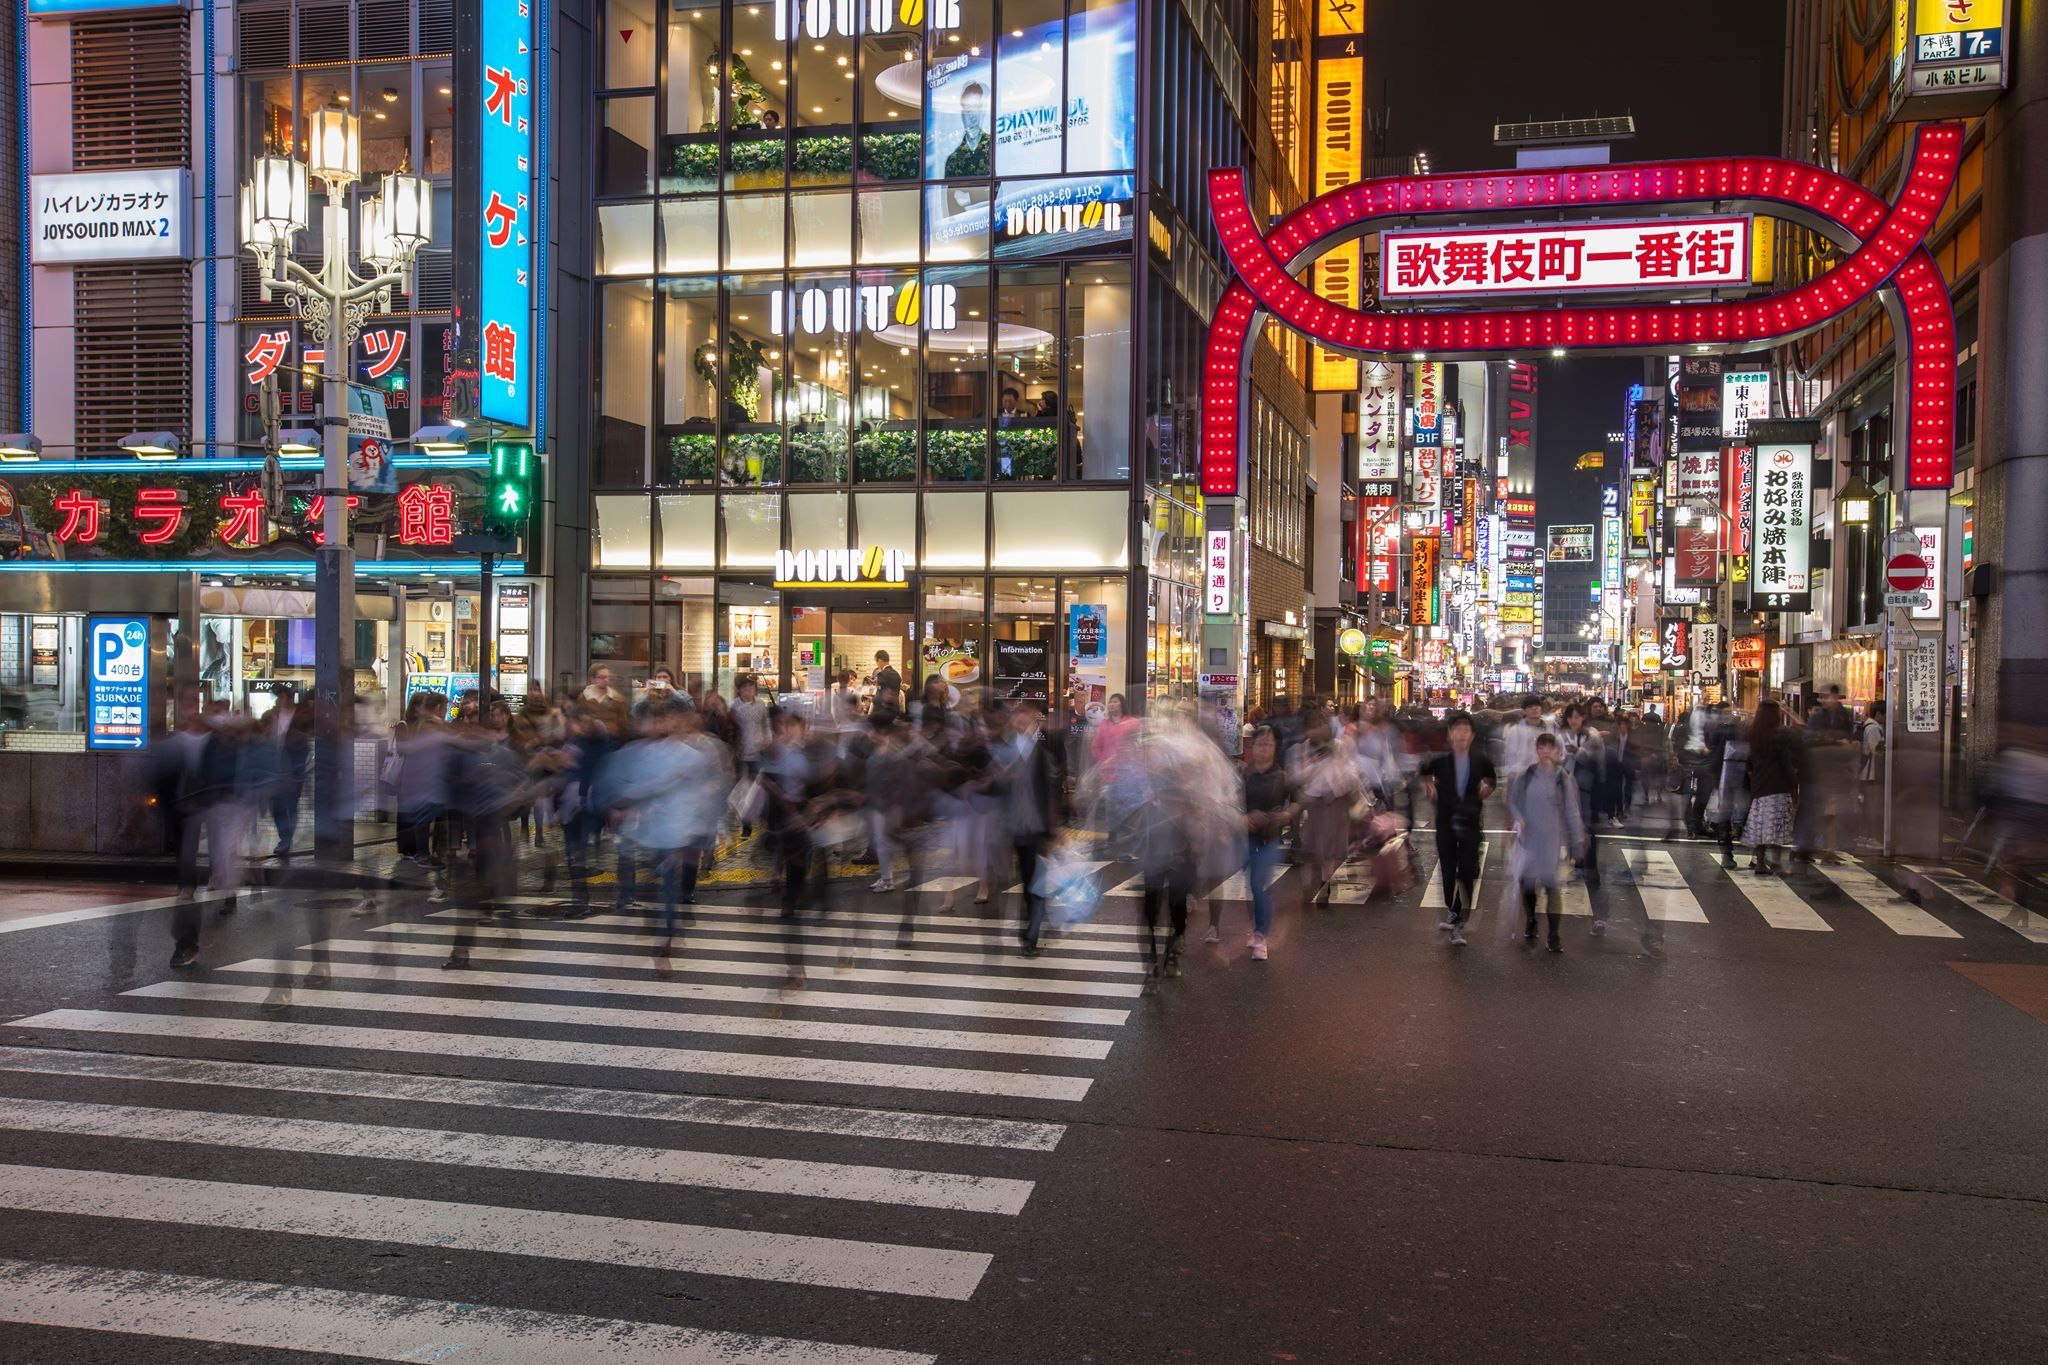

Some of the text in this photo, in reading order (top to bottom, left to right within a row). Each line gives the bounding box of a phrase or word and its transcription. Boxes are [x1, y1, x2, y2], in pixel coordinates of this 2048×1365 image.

[1345, 41, 1356, 56] 4
[1923, 32, 1992, 55] 本陣 7F
[1923, 48, 1956, 59] PART2
[1925, 67, 1987, 87] 小松ビル
[43, 191, 169, 215] ハイレゾカラオケ
[1007, 200, 1121, 237] DOUTOR
[43, 222, 119, 241] JOYSOUND
[1396, 229, 1735, 288] 歌舞伎町一番街
[245, 330, 407, 385] ダーツ
[1726, 374, 1768, 383] 全卓全自動
[245, 391, 313, 413] CFE
[383, 389, 409, 410] AR
[1364, 386, 1385, 454] バンタイ
[1387, 386, 1396, 449] タイ国料理専門店
[1415, 433, 1439, 444] B1F
[1371, 468, 1387, 477] 3F
[1365, 484, 1392, 496] 焼肉
[1762, 469, 1789, 585] お好み焼本陣
[775, 545, 905, 582] DOUTOR
[1212, 536, 1227, 607] 劇場通り
[1767, 594, 1791, 606] 2F
[1887, 595, 1925, 605] 自転車を除く
[127, 630, 143, 641] 24h
[98, 632, 124, 676] P
[928, 644, 976, 658] 秋のケーキ
[1919, 646, 1929, 716] 防犯カメラ作動中
[95, 694, 142, 704] SUBNADE
